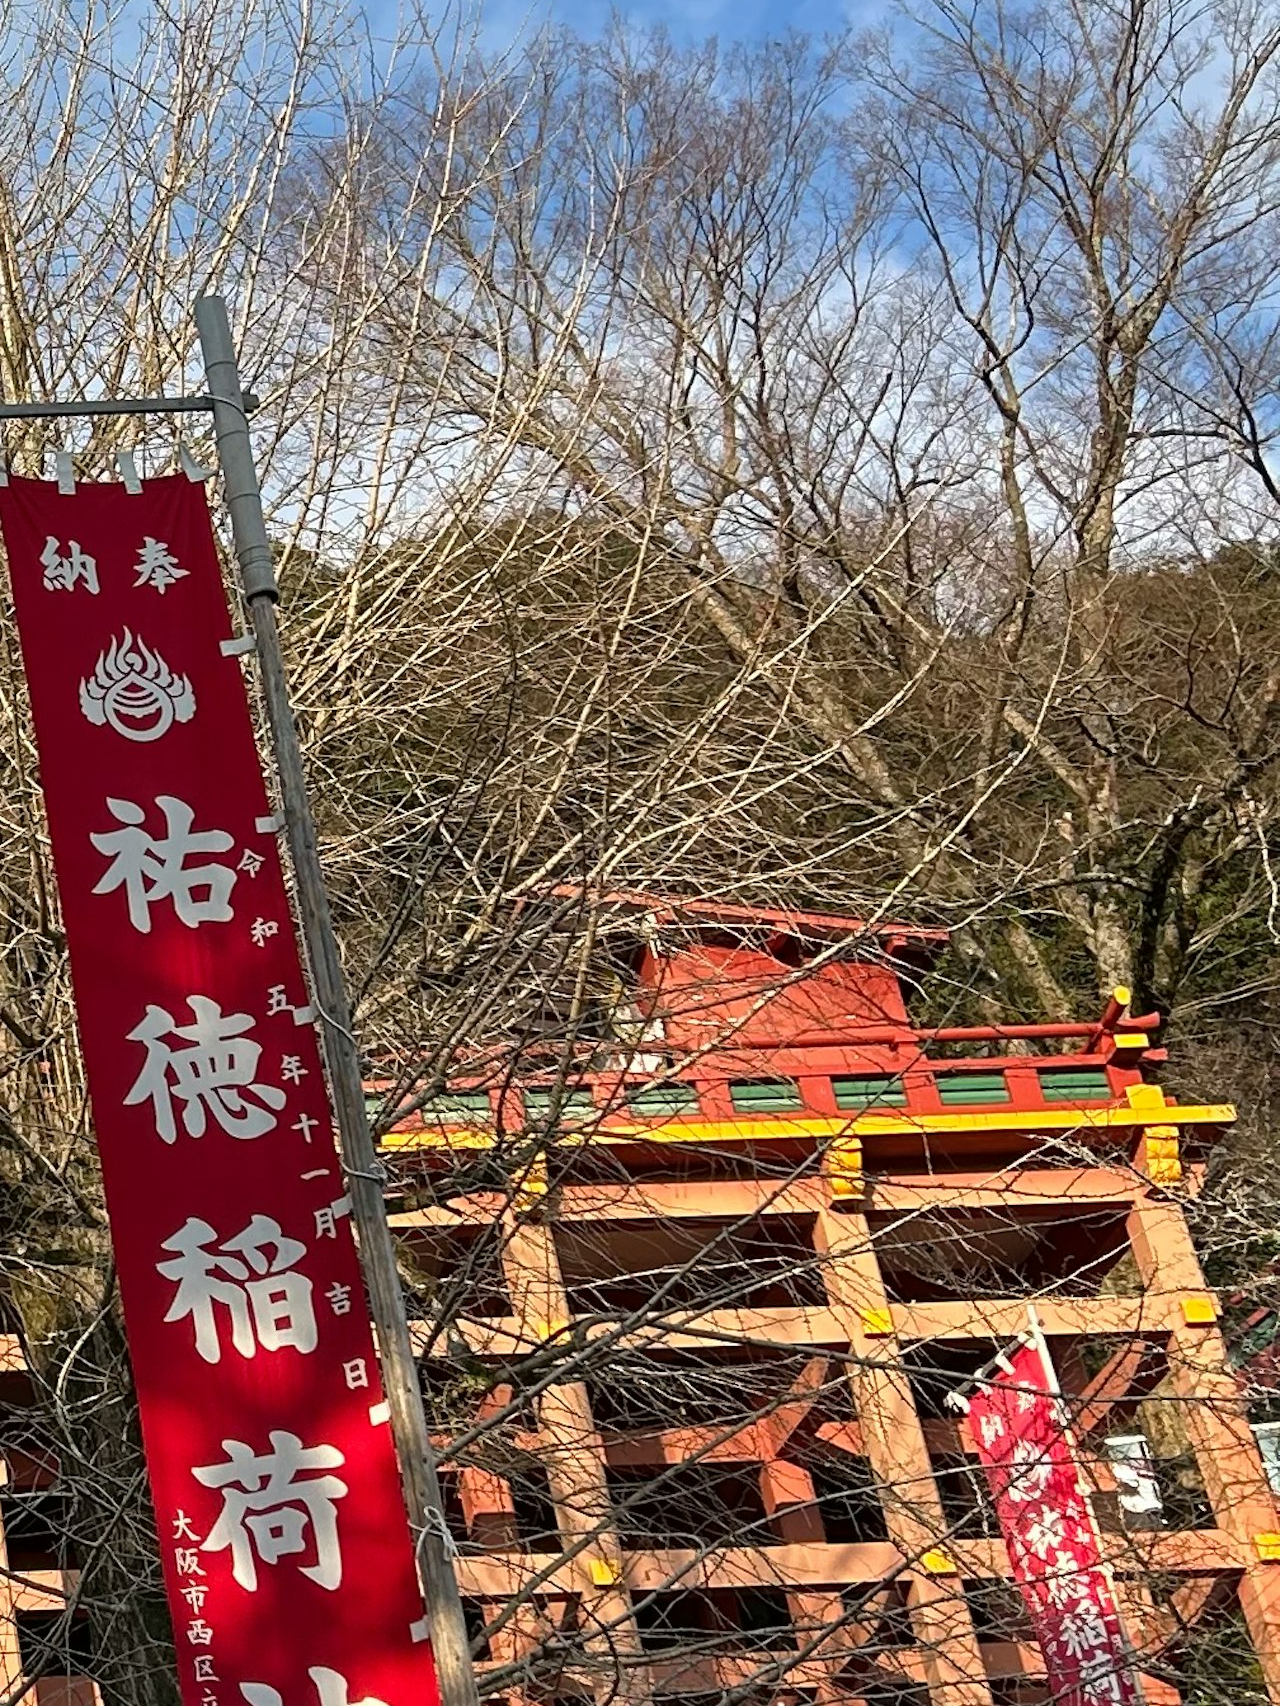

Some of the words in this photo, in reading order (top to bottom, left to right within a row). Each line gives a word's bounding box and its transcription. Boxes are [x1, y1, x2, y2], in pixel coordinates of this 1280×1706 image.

[236, 848, 370, 1392] 令和五年十一月吉日
